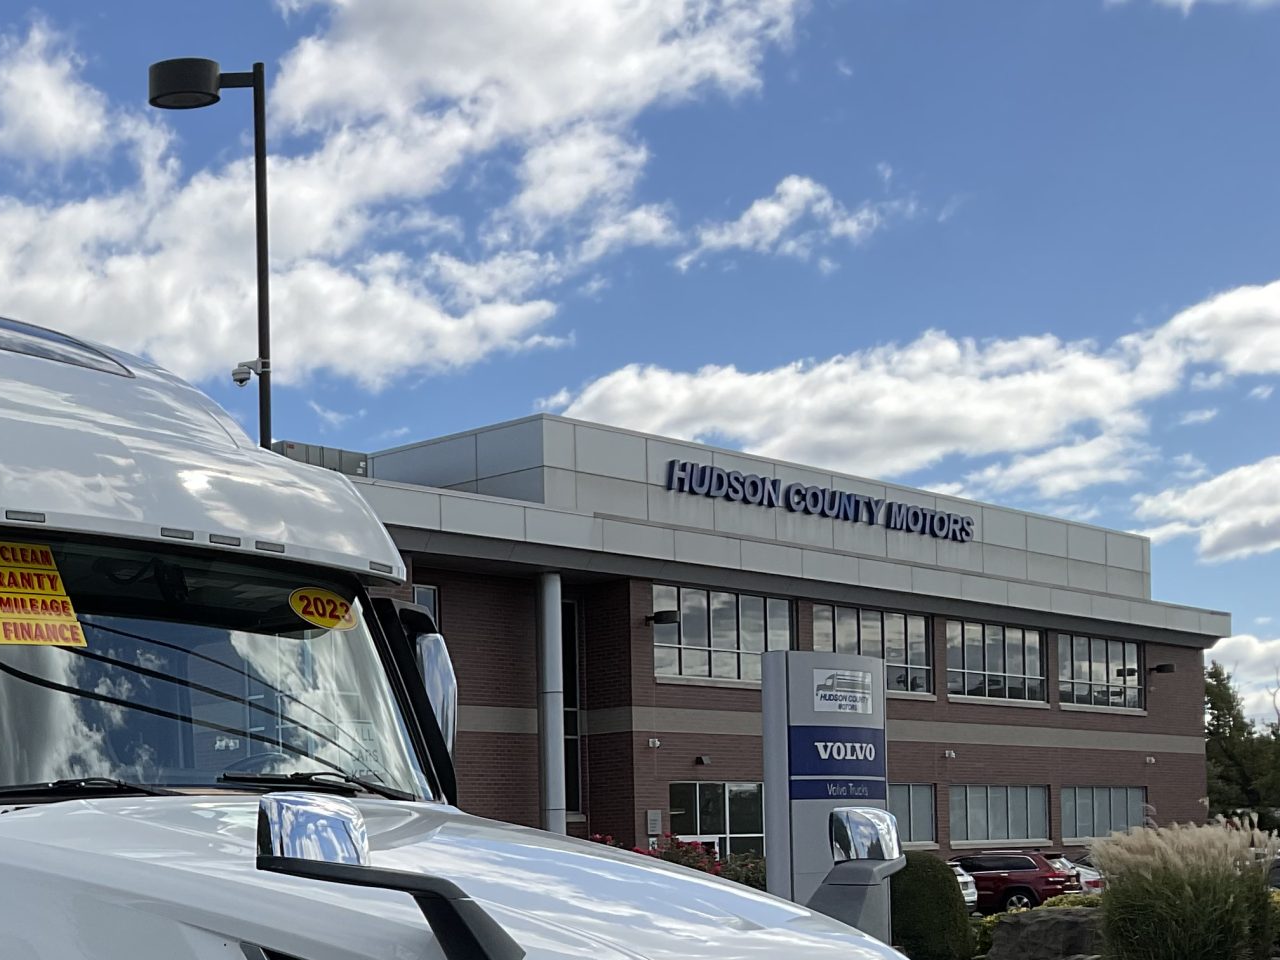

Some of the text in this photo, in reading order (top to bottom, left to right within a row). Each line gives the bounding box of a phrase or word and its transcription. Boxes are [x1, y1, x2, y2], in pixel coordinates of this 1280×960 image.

[668, 459, 974, 542] HUDSON COUNTY MOTORS
[0, 545, 53, 566] CLEAN
[0, 596, 73, 617] MILEAGE
[2, 622, 82, 643] FINANCE
[820, 693, 847, 702] HUDSON
[814, 742, 876, 761] VOLVO
[827, 783, 847, 796] Volvo
